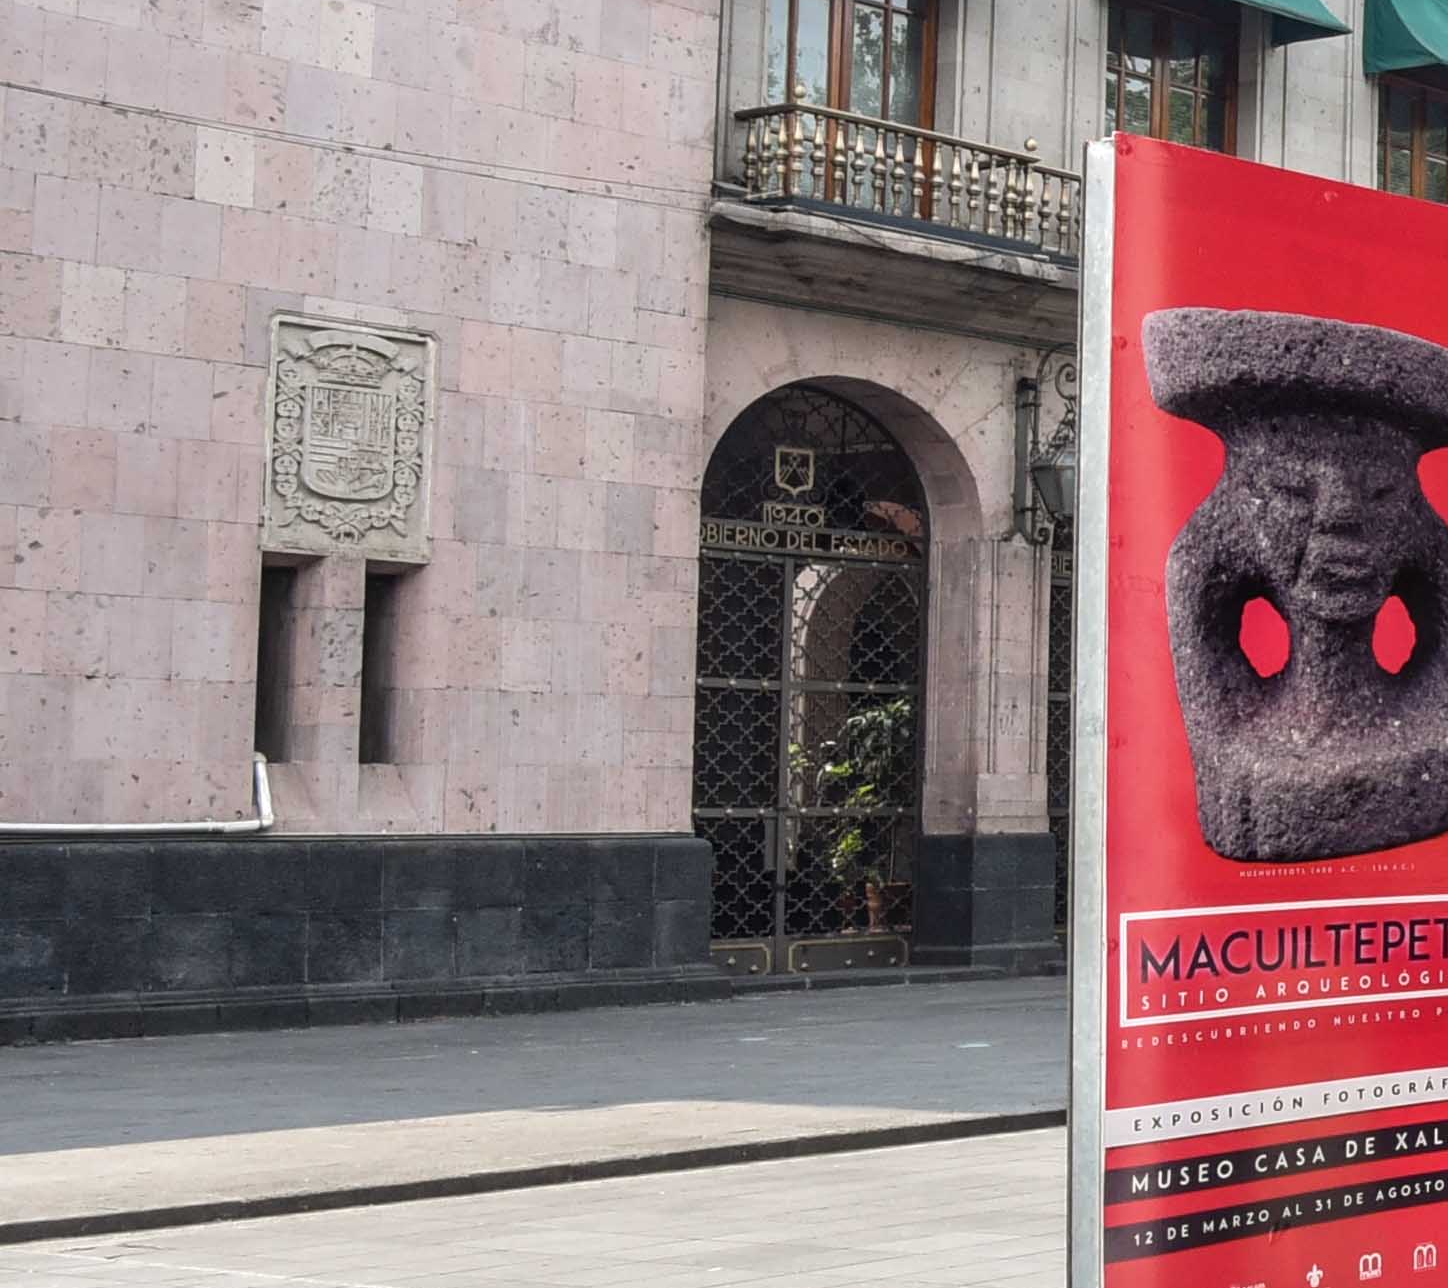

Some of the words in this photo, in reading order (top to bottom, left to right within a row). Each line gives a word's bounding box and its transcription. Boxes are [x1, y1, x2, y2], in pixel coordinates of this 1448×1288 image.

[768, 507, 821, 528] 1940
[787, 532, 823, 552] DEL
[831, 535, 908, 558] ESTADO
[1141, 987, 1230, 1011] SITIO
[1121, 1017, 1318, 1050] REDESCUBRIENDO
[1333, 1007, 1421, 1026] NUESTRO
[1133, 1096, 1303, 1132] EXPOSICIÓN
[1131, 1160, 1234, 1194] MUSEO
[1254, 1146, 1327, 1173] CASA
[1345, 1137, 1376, 1159] DE
[1134, 1230, 1155, 1247] 12
[1167, 1223, 1190, 1241] DE
[1203, 1208, 1270, 1235] MARZO
[1282, 1202, 1303, 1219] AL
[1315, 1197, 1333, 1212] 31
[1343, 1192, 1365, 1208] DE
[1376, 1177, 1445, 1202] AGOSTO
